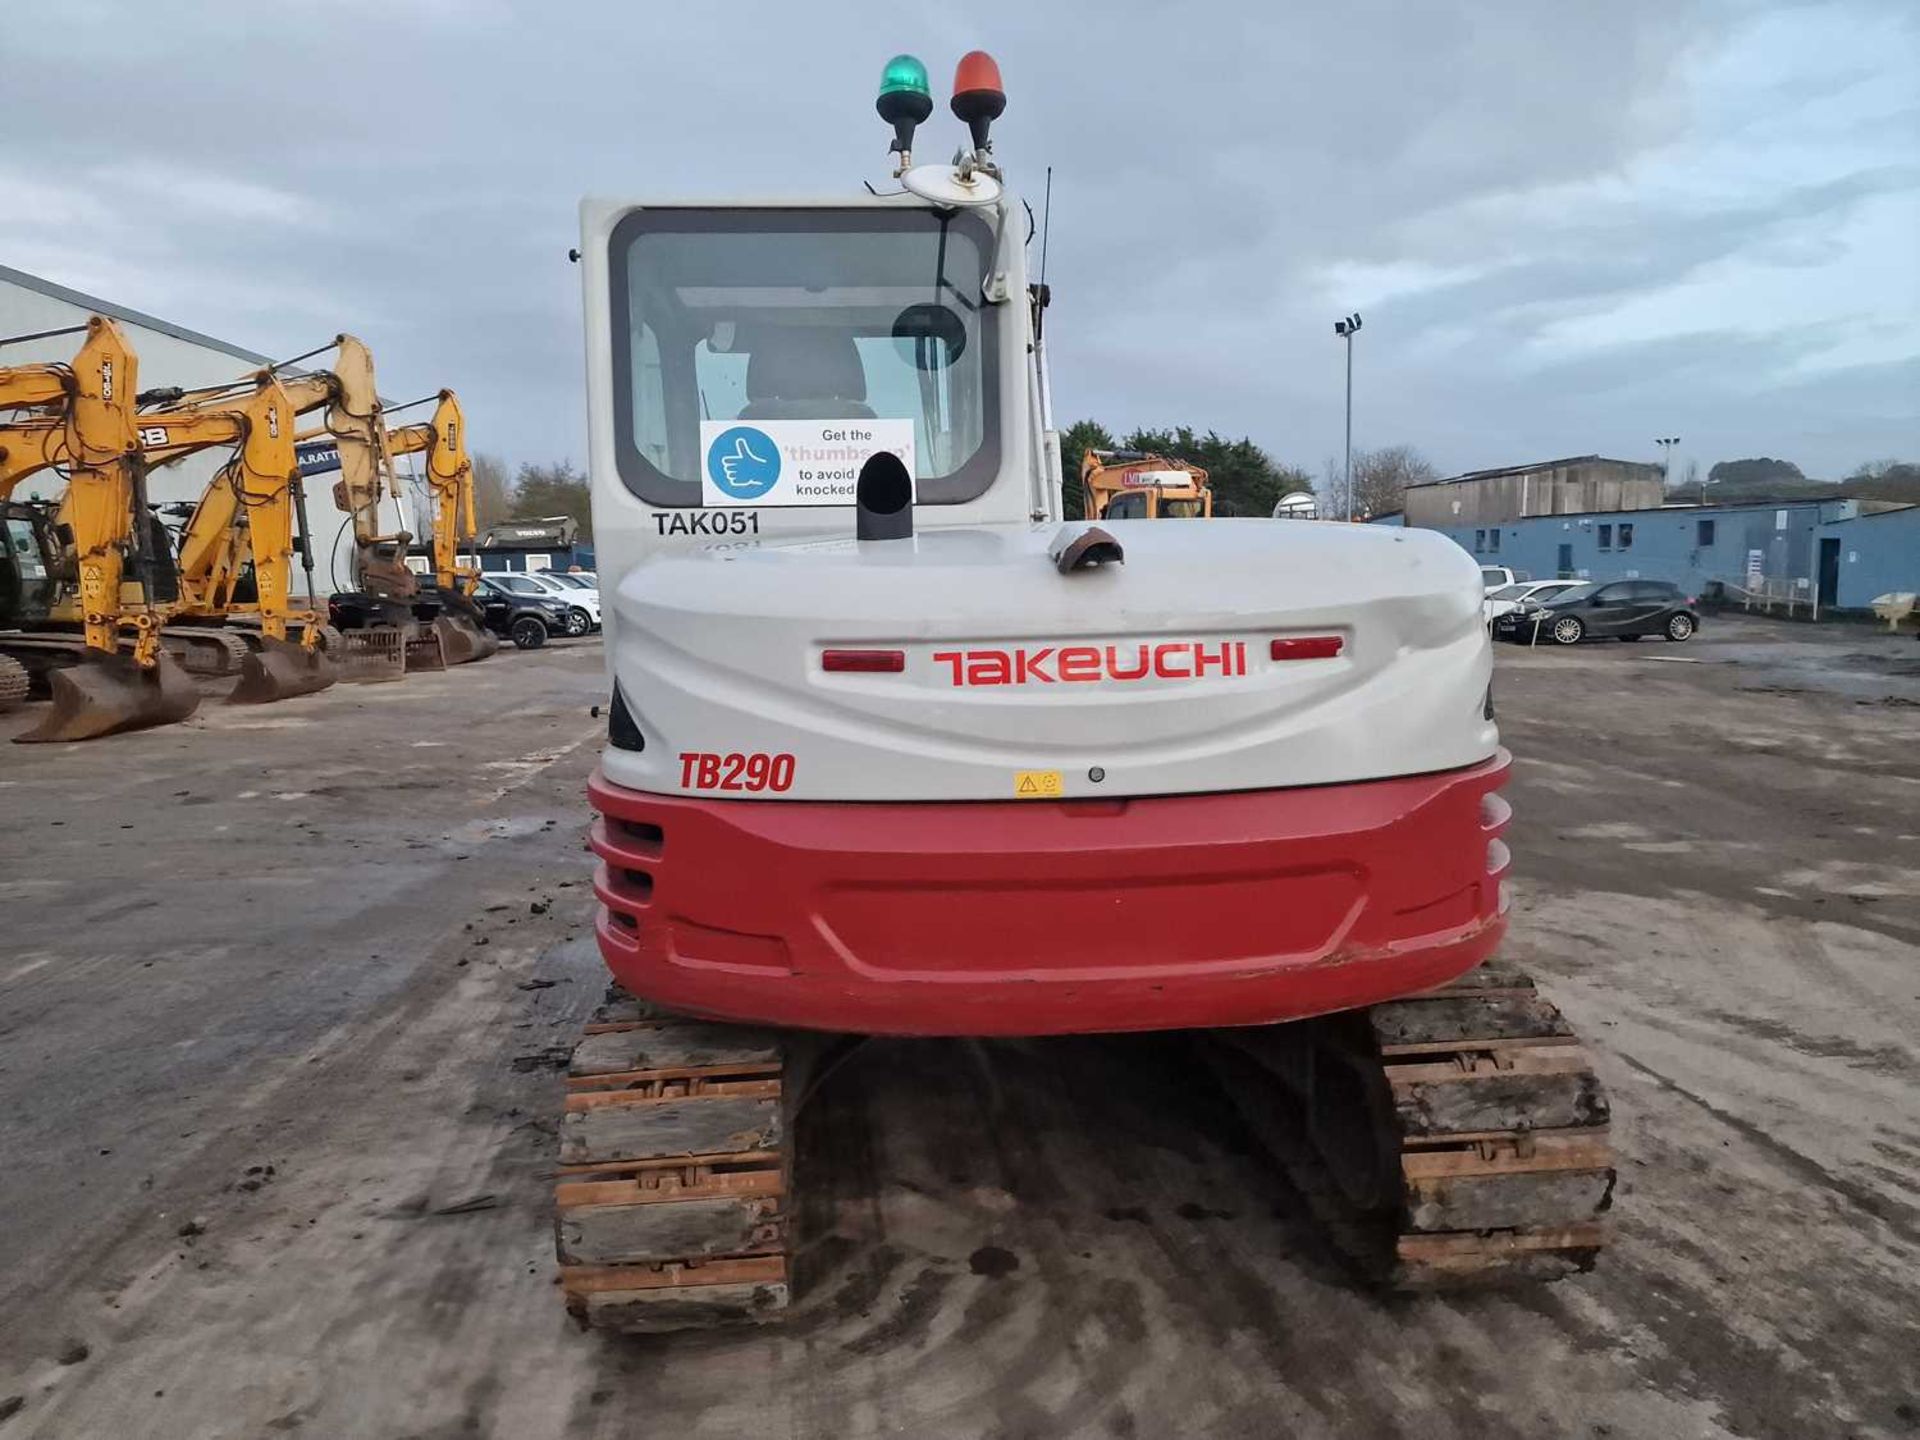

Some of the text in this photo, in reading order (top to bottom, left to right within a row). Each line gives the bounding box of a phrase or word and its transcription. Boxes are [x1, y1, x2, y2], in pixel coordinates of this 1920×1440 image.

[822, 429, 872, 441] Get the
[799, 468, 855, 480] to avoid
[796, 484, 855, 495] knocked
[651, 511, 759, 535] TAK051
[933, 642, 1246, 686] TAKEUCHI
[679, 752, 795, 792] TB290
